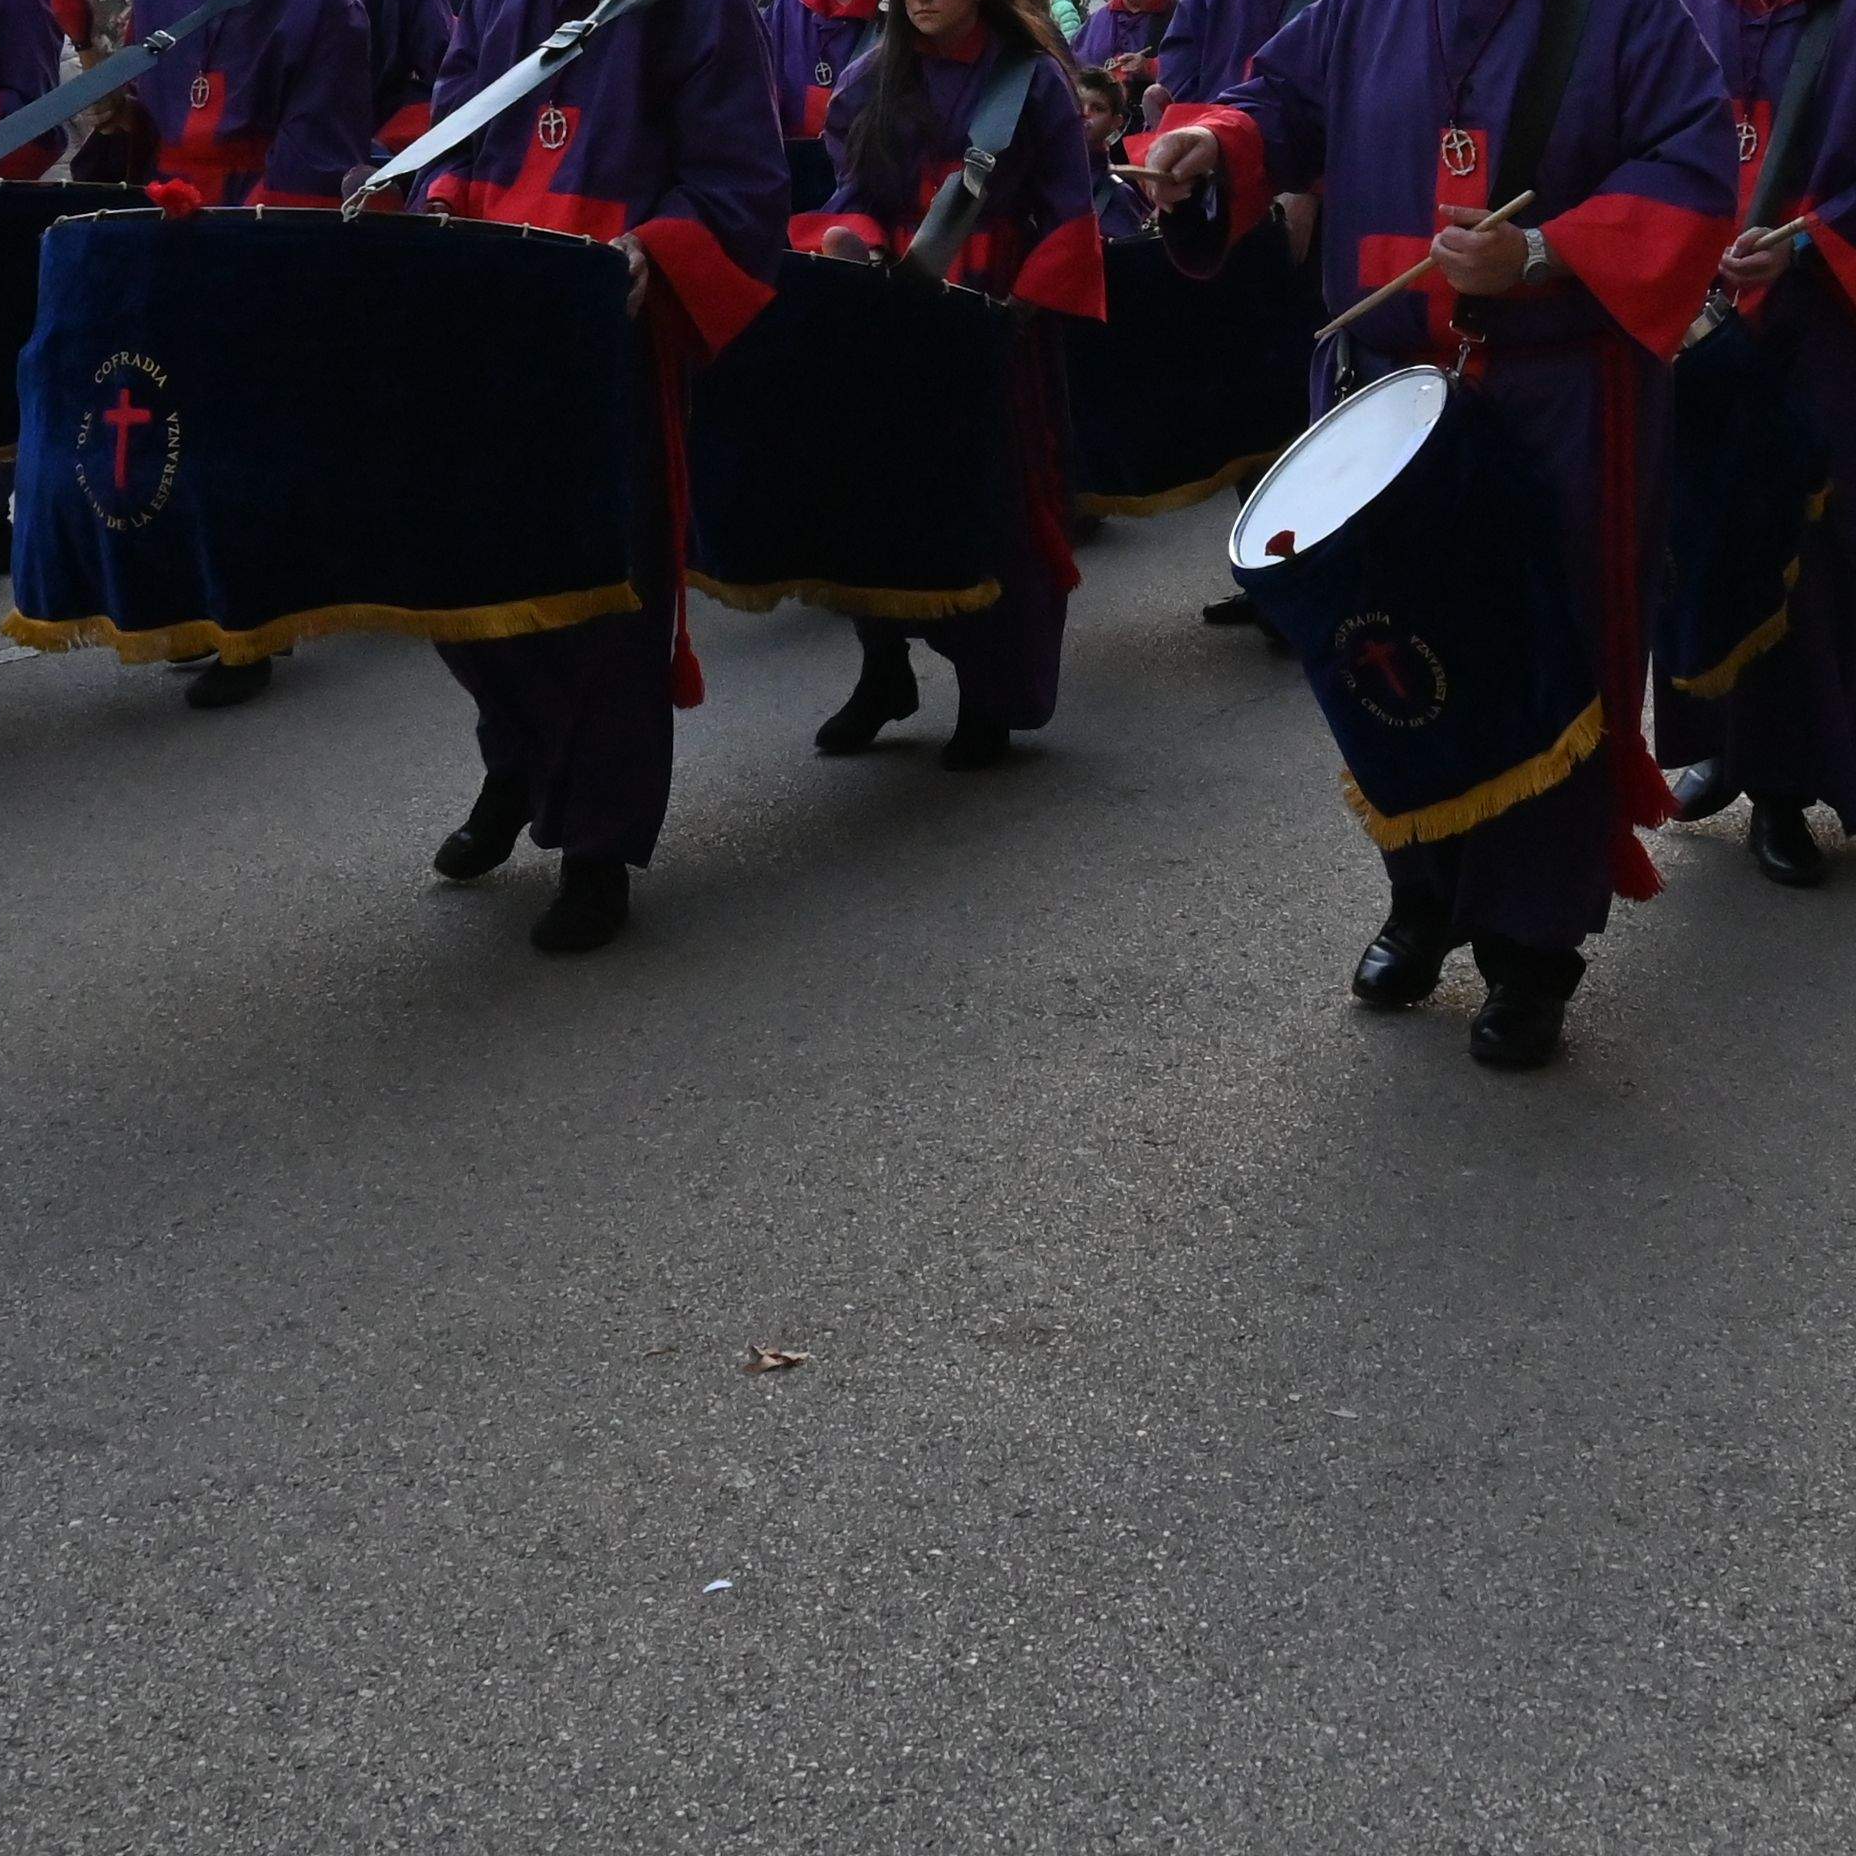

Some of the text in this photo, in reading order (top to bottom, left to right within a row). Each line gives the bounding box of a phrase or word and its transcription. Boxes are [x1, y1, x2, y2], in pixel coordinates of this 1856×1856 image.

[94, 350, 169, 389] COFRADIA
[130, 511, 154, 529] LA
[149, 409, 184, 511] ESPERANZA
